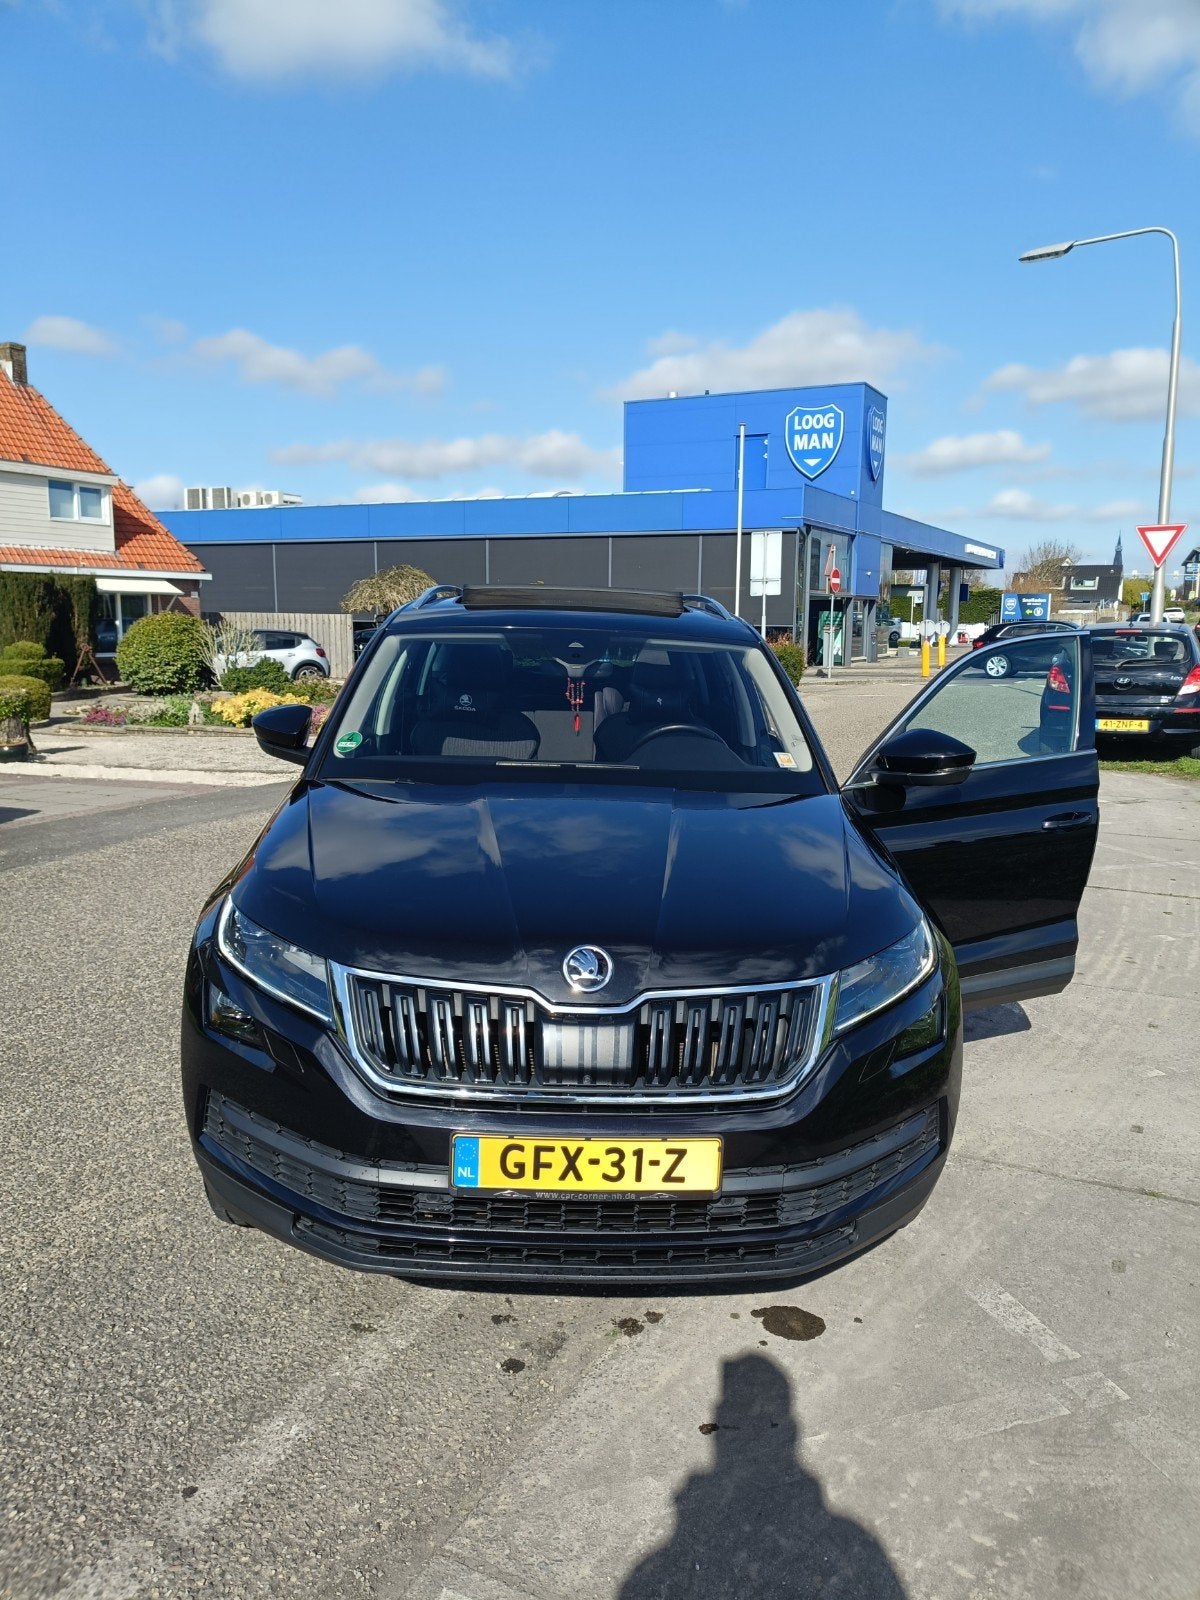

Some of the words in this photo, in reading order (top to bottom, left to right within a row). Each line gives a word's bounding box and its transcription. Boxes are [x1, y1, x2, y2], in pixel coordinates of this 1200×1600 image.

[794, 413, 835, 431] LOOG
[794, 432, 834, 451] MAN
[1102, 720, 1144, 729] 41-ZNF-4
[457, 1167, 475, 1178] NL
[499, 1143, 688, 1184] GFX-31-Z
